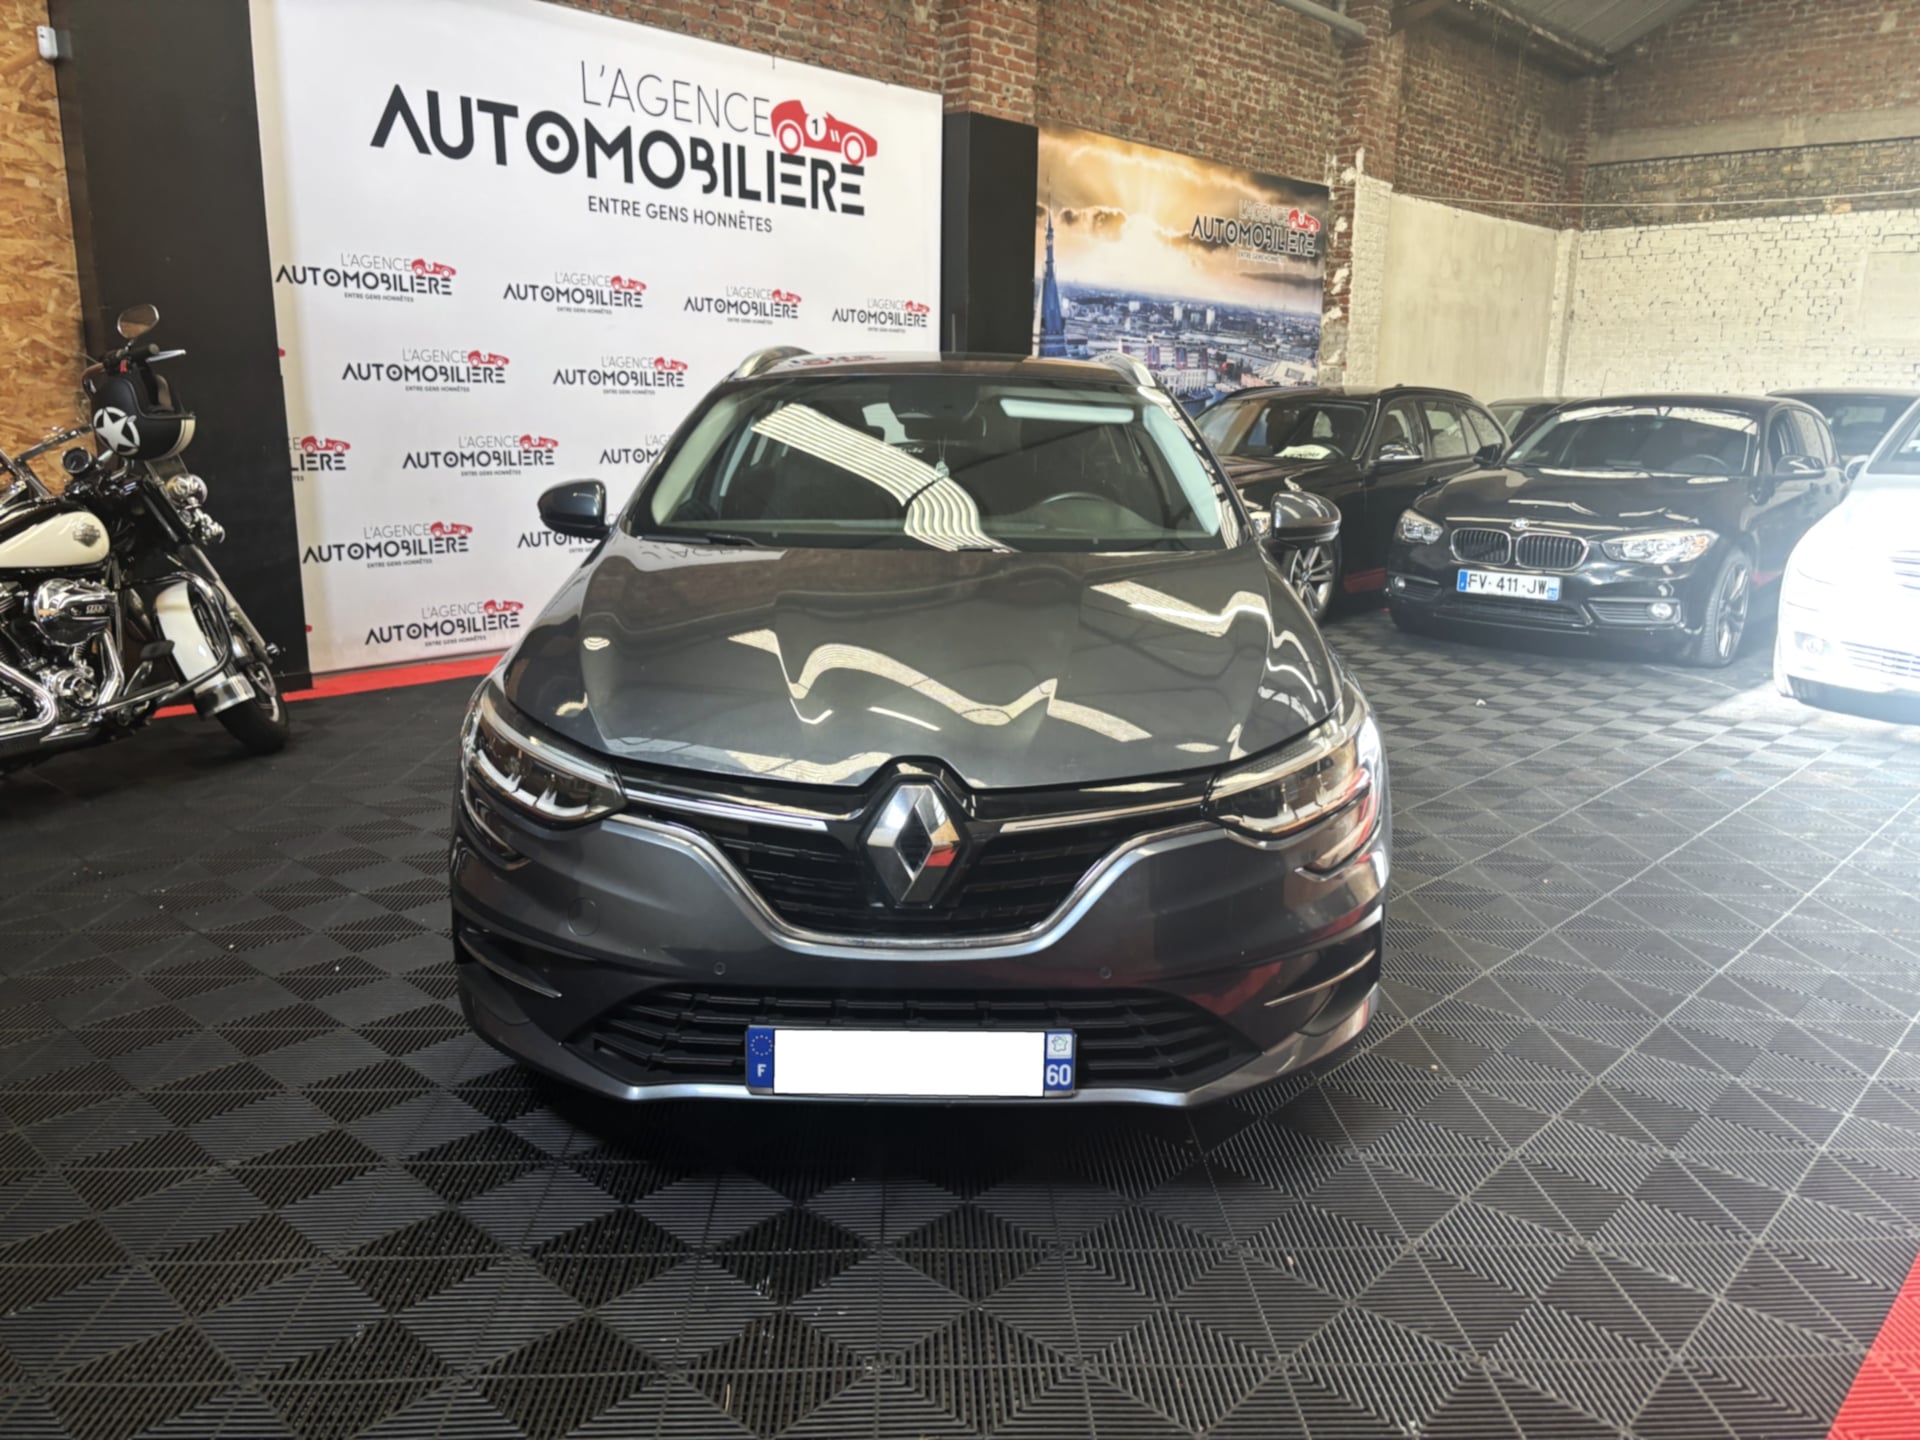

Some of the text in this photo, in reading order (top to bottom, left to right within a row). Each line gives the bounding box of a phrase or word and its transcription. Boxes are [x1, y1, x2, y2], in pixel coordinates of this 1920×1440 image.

[581, 60, 771, 137] L'AGENCE
[370, 83, 865, 216] AUTOMOBILIERE
[588, 195, 772, 233] ENTRE GENS HONNÊTES
[341, 253, 412, 272] L'AGENCE
[555, 272, 611, 287] L'AGENCE
[403, 348, 467, 364] L'AGENCE
[601, 356, 654, 368] L'AGENCE
[459, 435, 519, 448] L'AGENCE
[364, 523, 430, 539] L'AGENCE
[421, 602, 484, 619] L'AGENCE
[757, 1064, 767, 1077] F
[1046, 1064, 1071, 1085] 60
